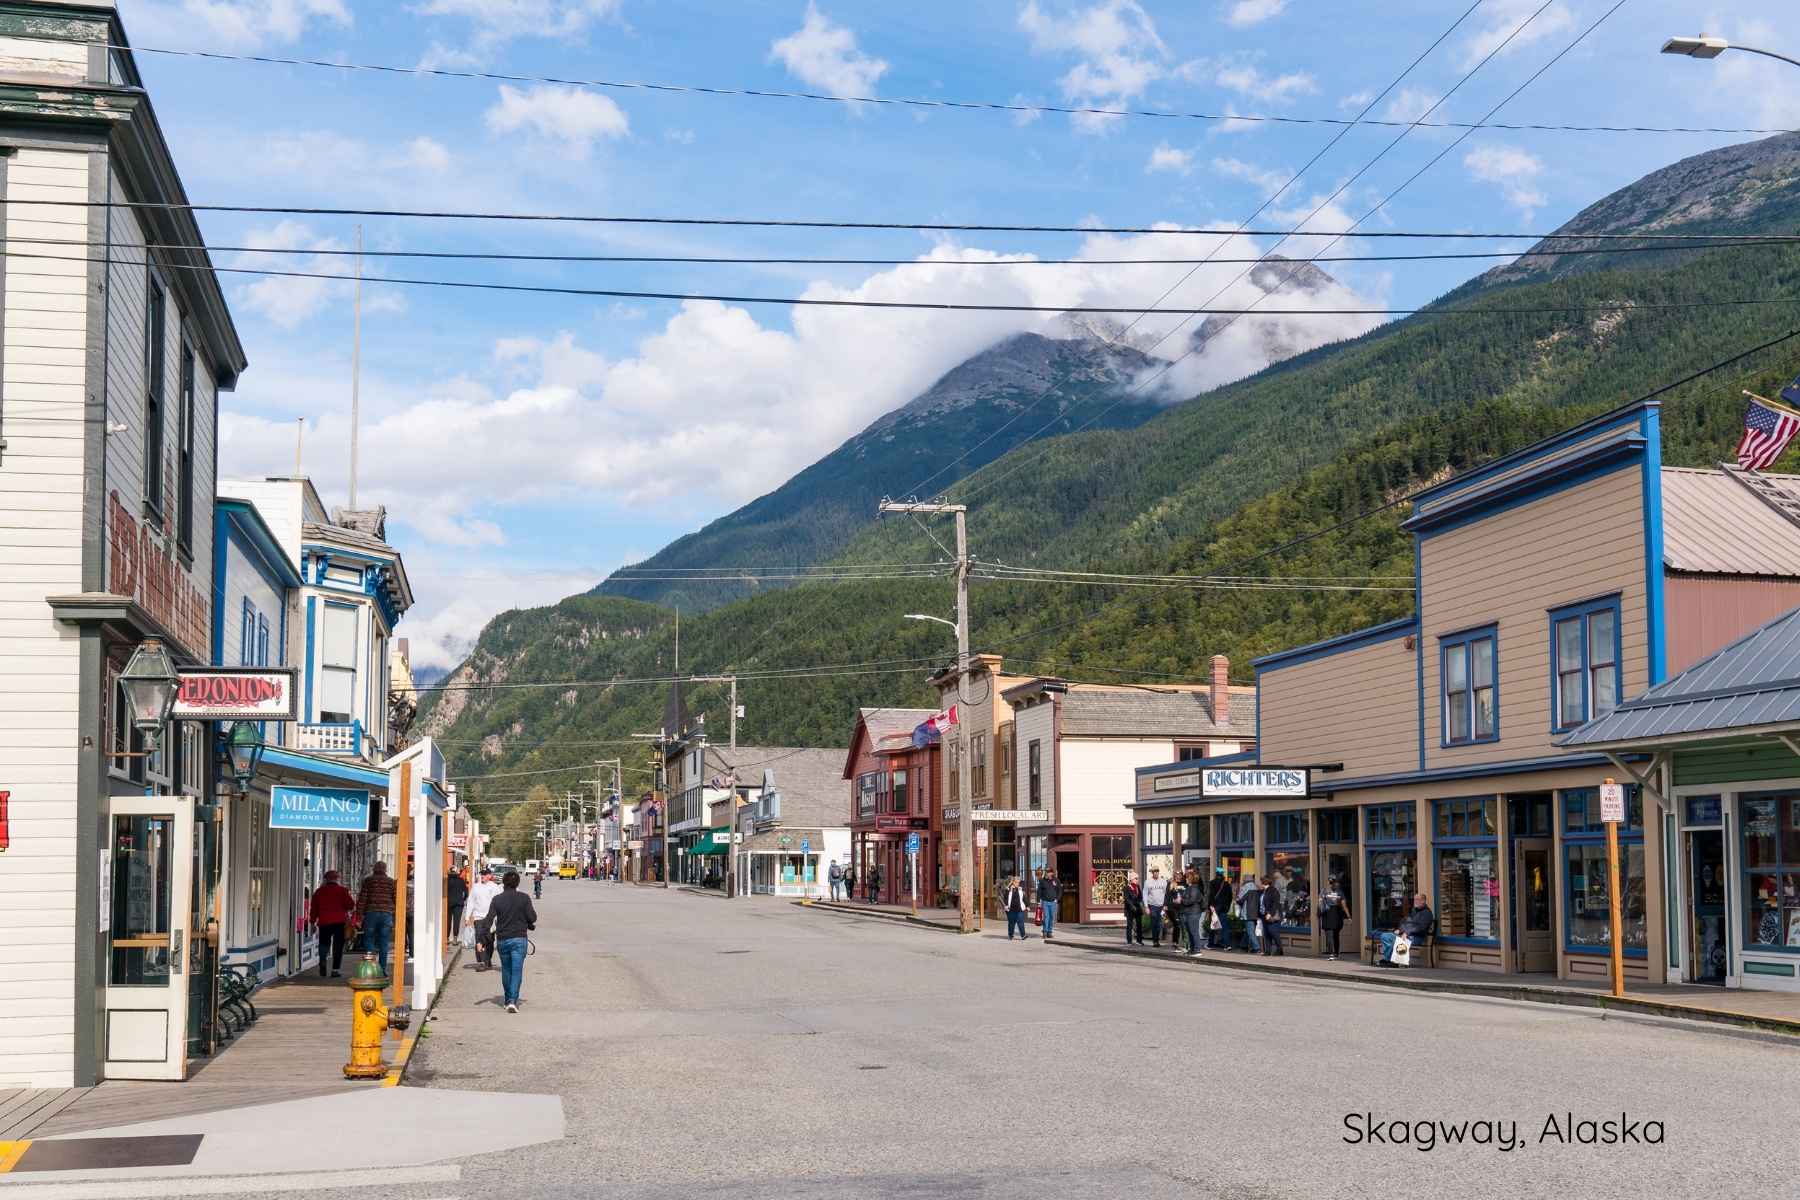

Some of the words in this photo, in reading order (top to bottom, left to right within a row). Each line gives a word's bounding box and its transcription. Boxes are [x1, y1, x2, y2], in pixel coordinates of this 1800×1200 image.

[211, 677, 275, 701] ONION
[1207, 770, 1302, 790] RICHTERS
[281, 794, 361, 813] MILANO
[280, 813, 321, 821] DIAMOND
